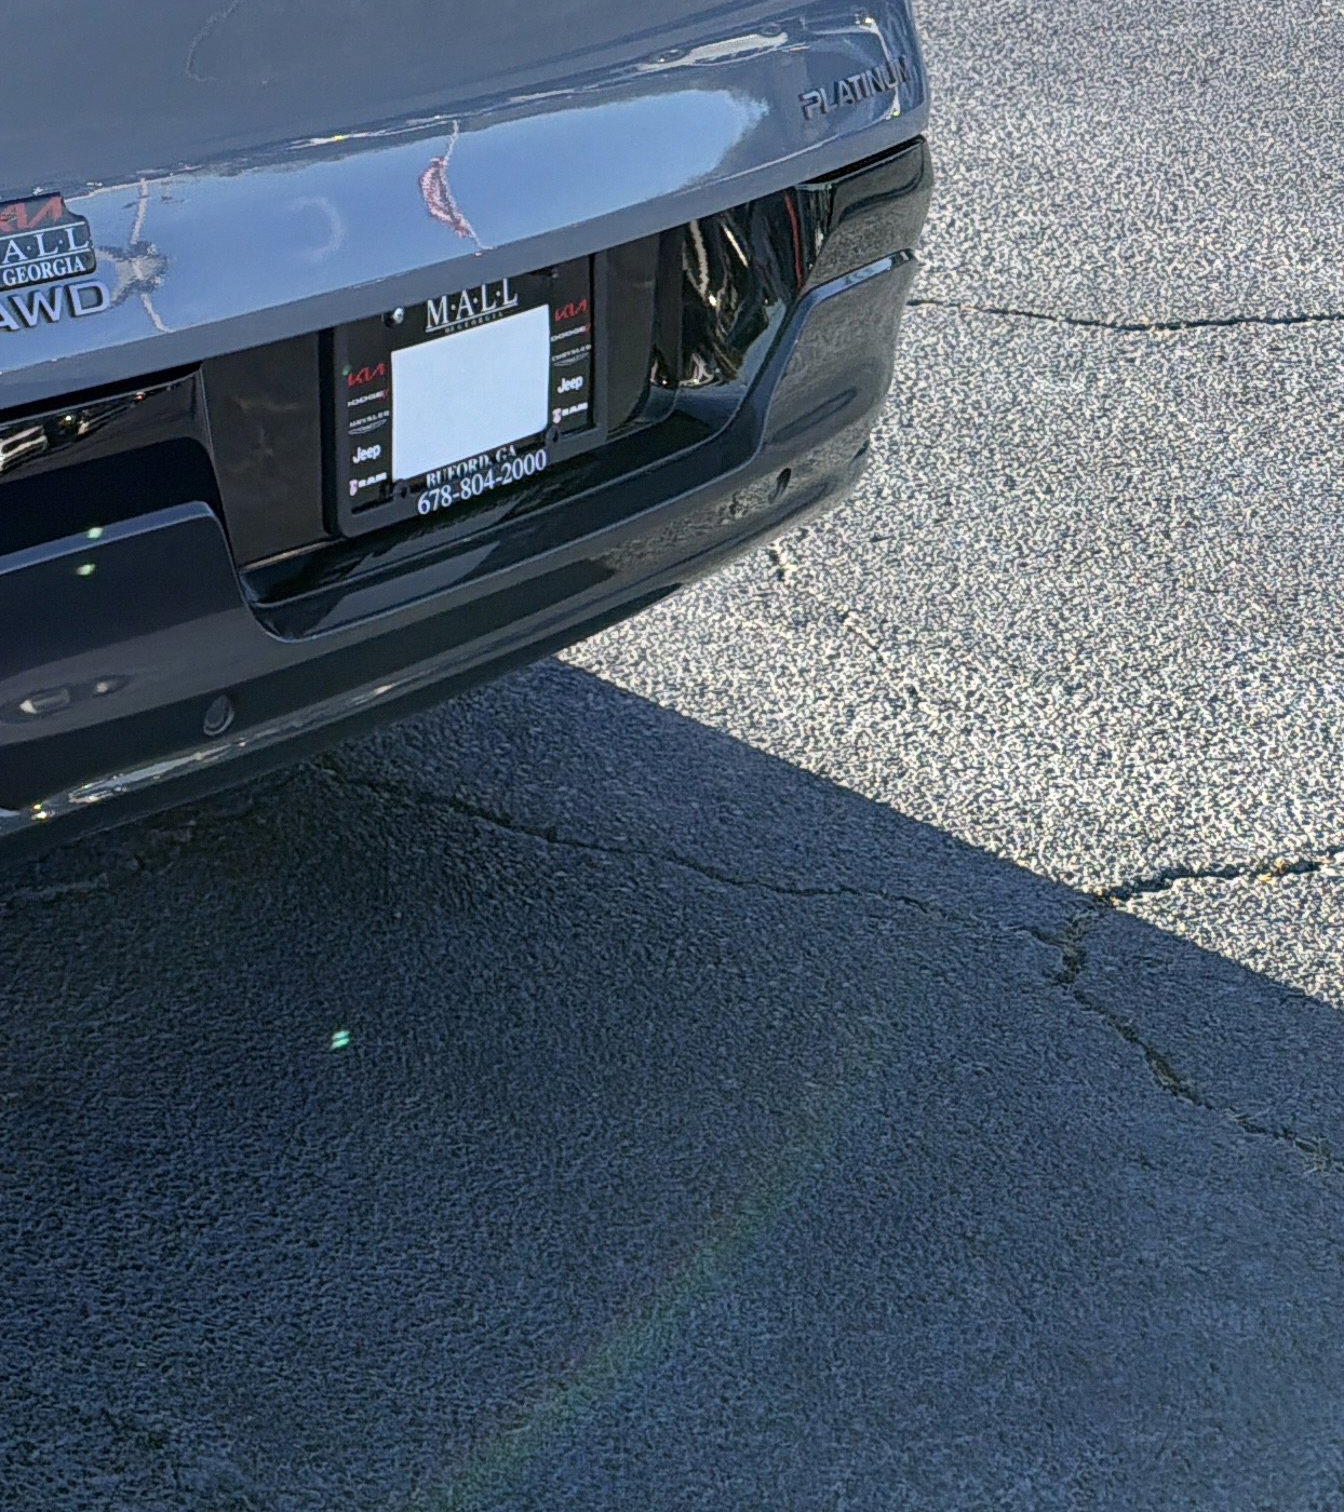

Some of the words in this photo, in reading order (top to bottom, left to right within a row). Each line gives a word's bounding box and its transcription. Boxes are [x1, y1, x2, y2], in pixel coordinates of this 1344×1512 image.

[2, 255, 86, 286] GEORGIA
[555, 298, 588, 322] KIA
[348, 363, 385, 386] KIA
[557, 376, 584, 394] Jeep
[352, 445, 381, 464] Jeep
[495, 444, 517, 462] GA
[417, 449, 547, 516] 678-804-2000
